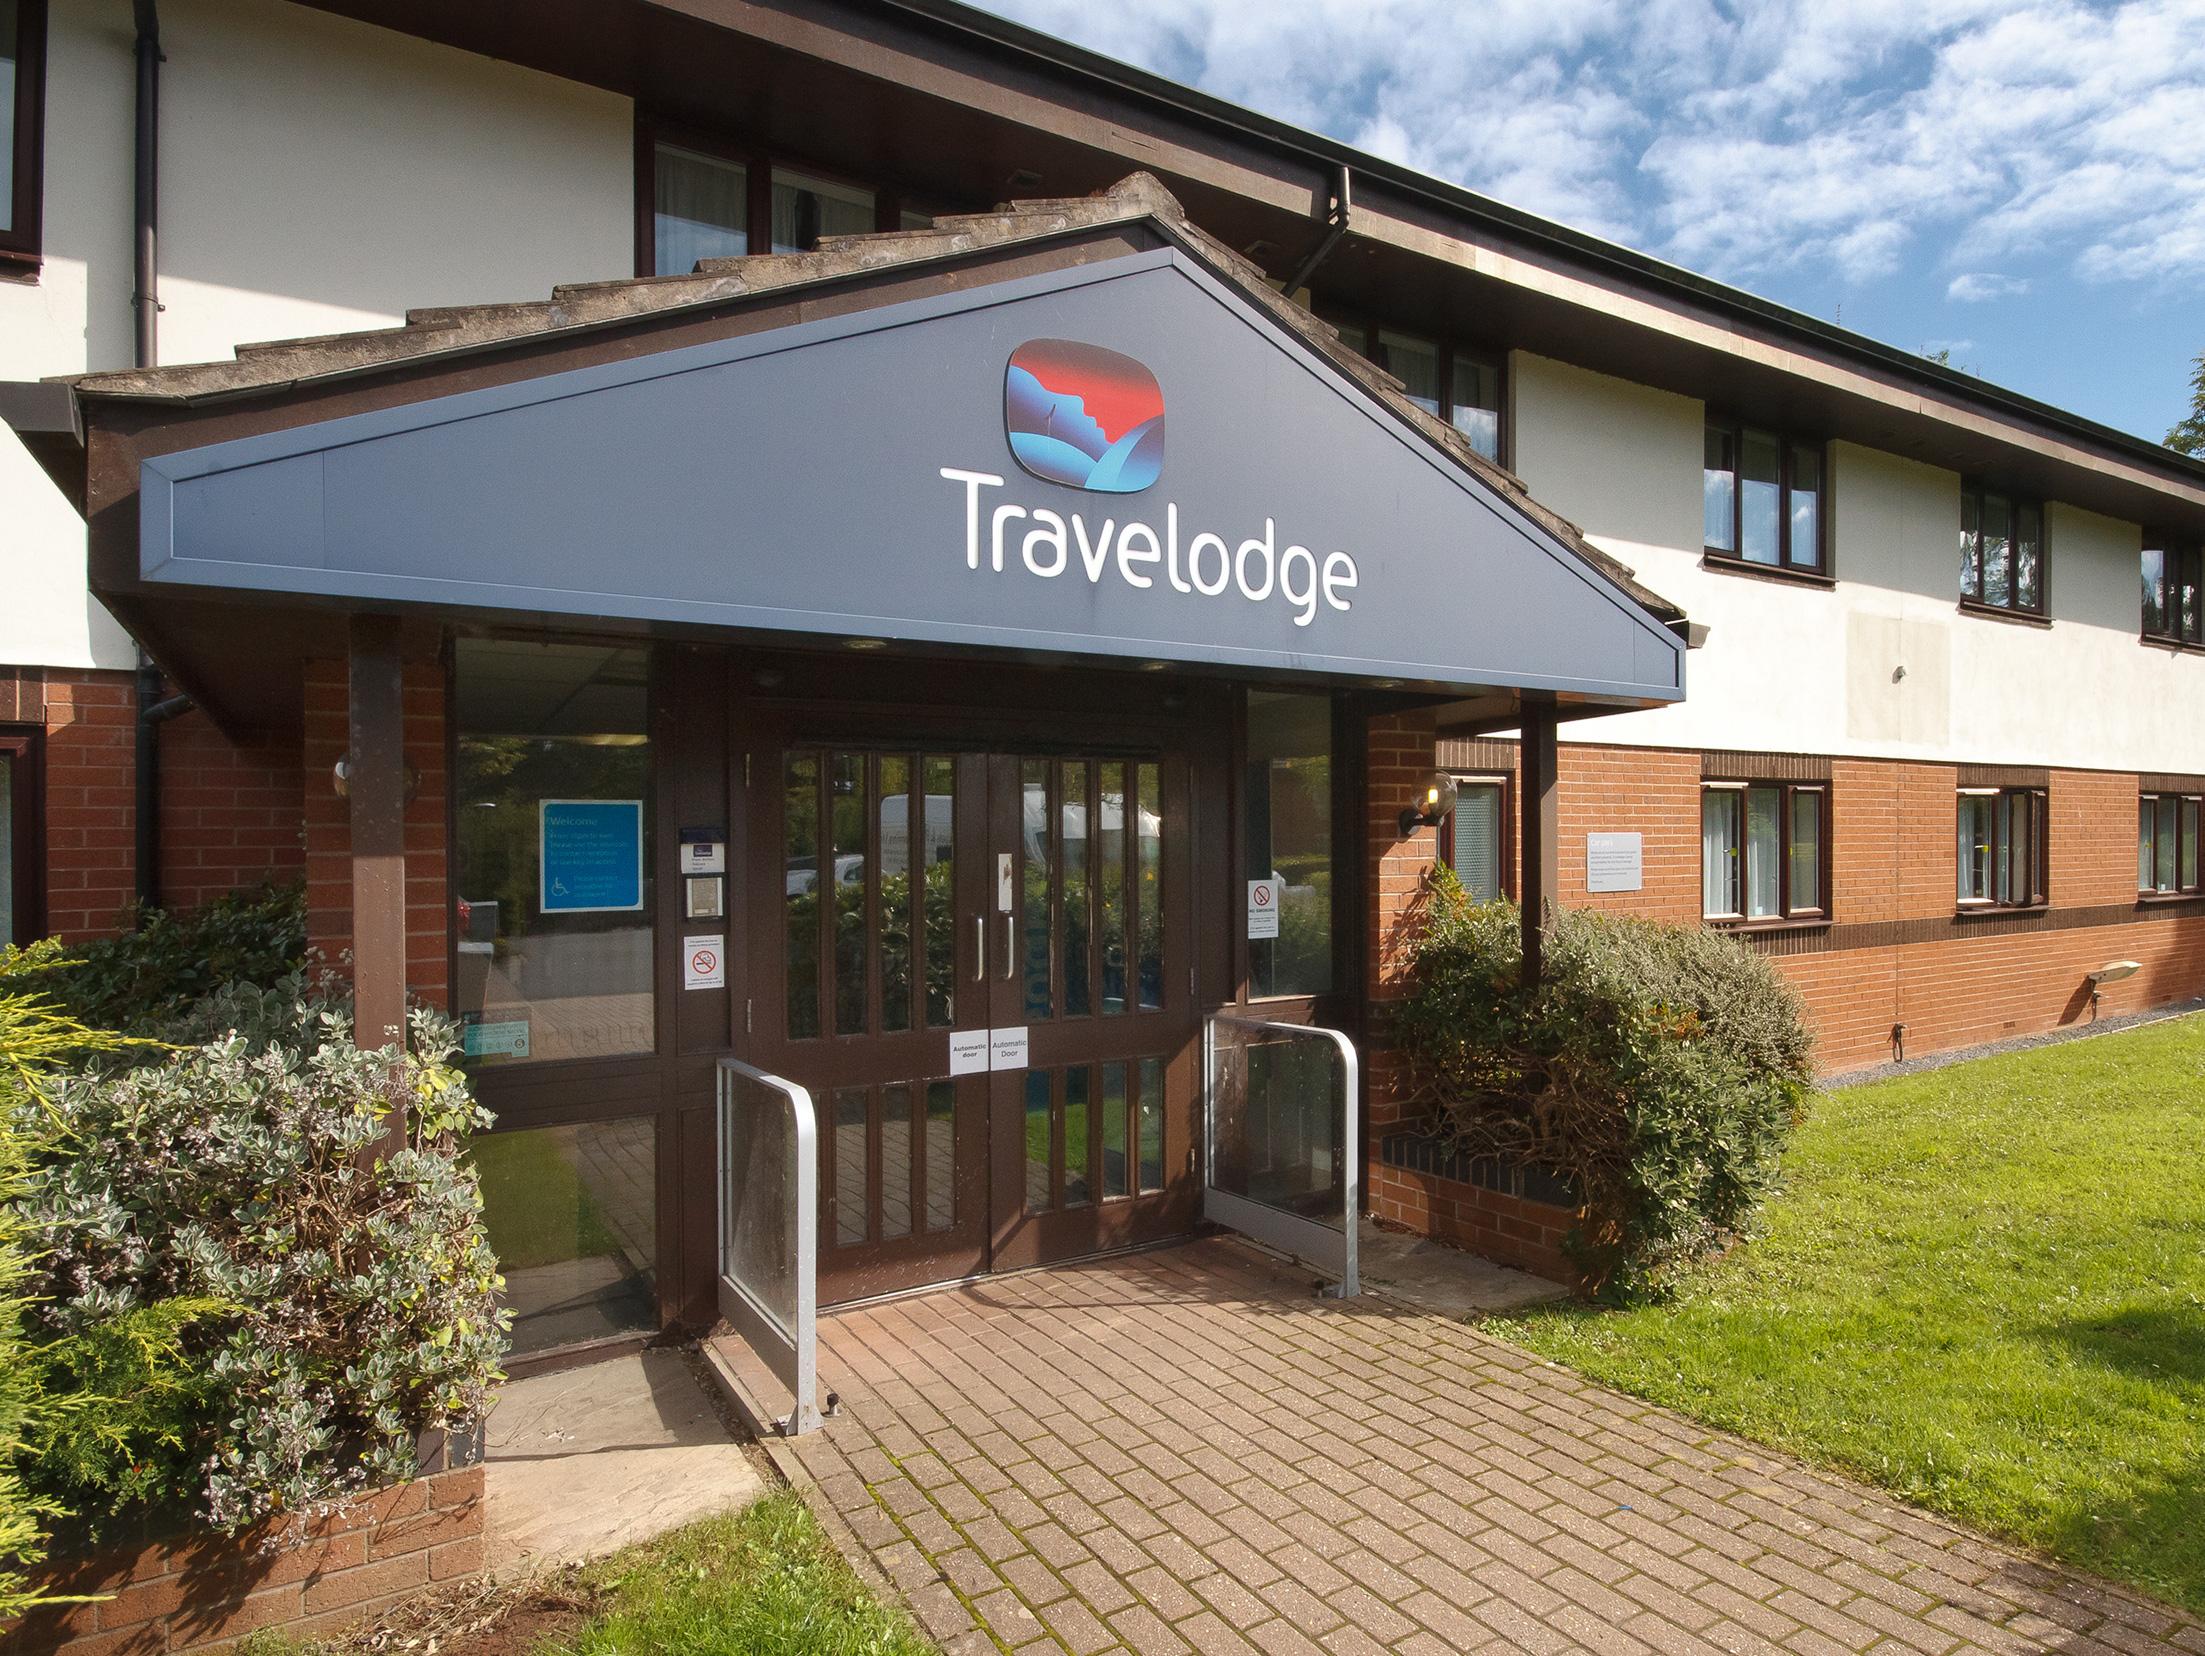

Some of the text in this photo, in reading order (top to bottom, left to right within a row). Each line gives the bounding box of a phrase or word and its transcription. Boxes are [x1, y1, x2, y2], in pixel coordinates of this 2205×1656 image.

[939, 467, 1361, 628] Travelodge
[550, 816, 598, 826] Welcome
[953, 1043, 987, 1052] Automatic
[992, 1039, 1027, 1049] Automatic
[1001, 1050, 1018, 1058] Door
